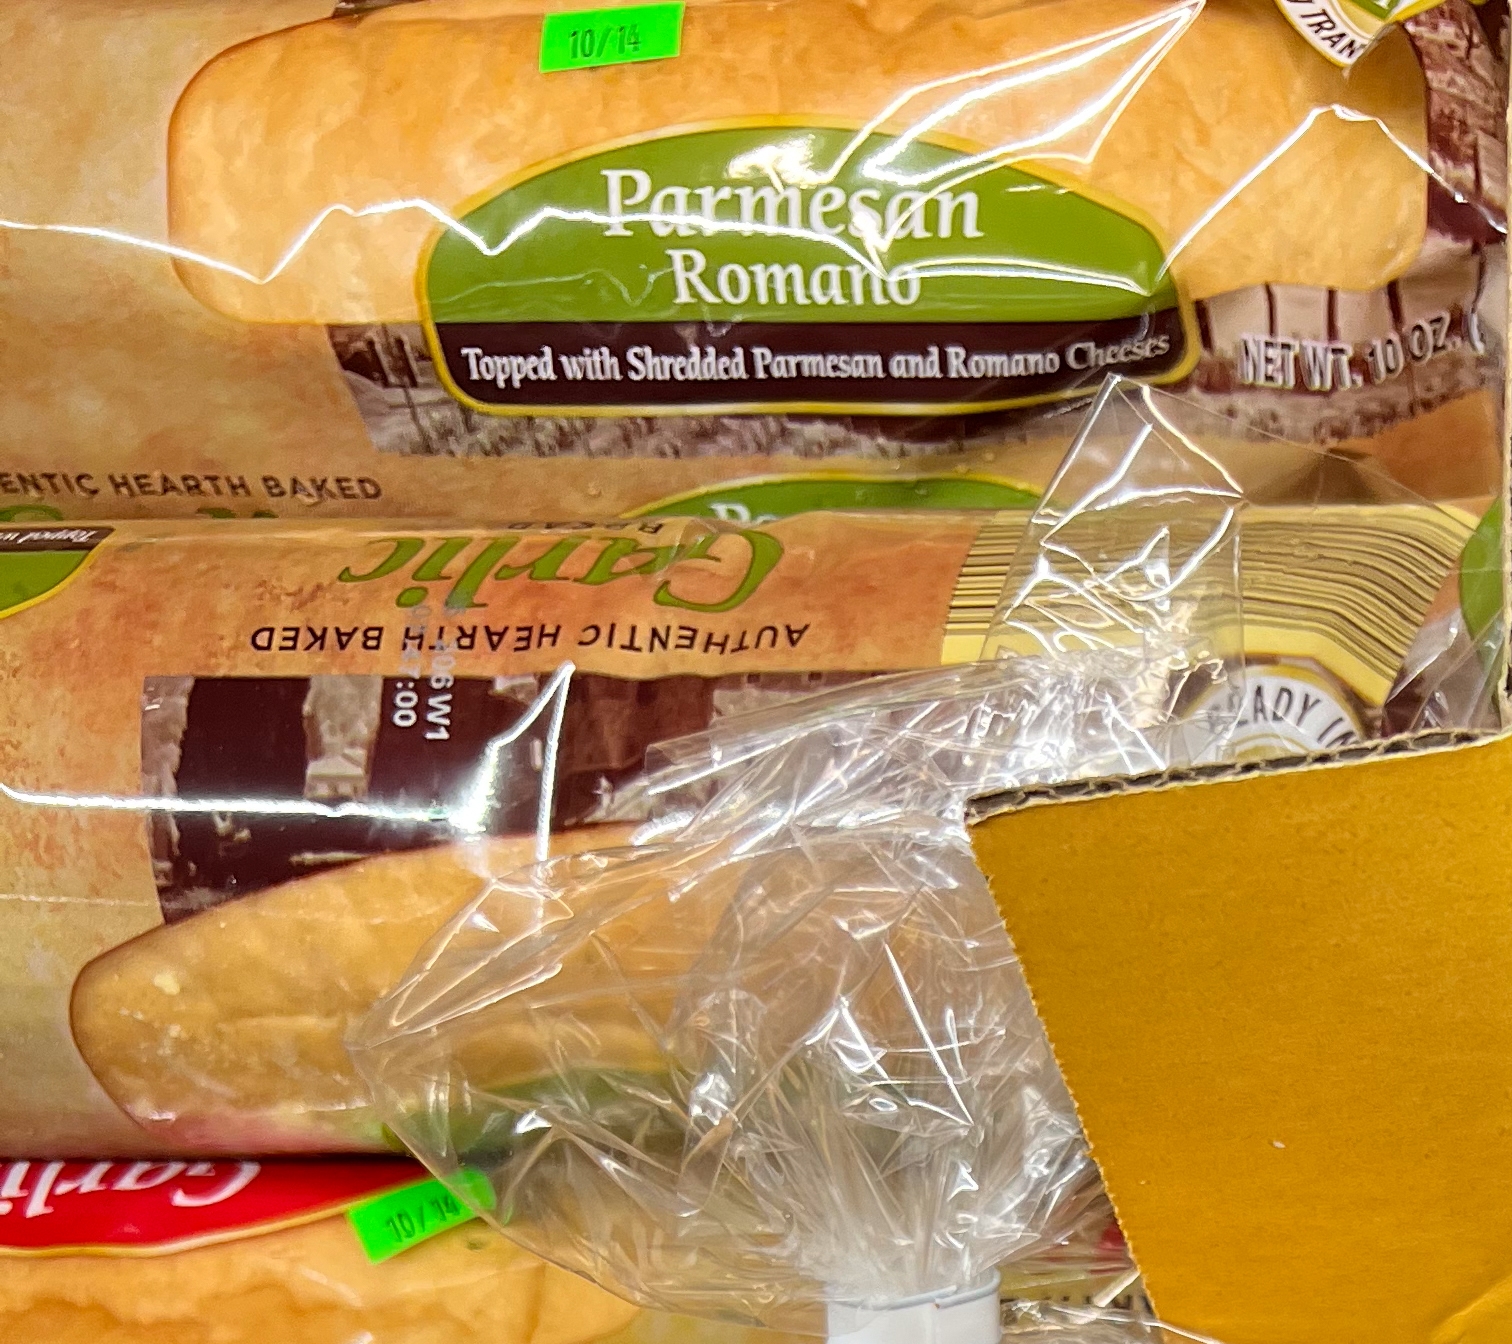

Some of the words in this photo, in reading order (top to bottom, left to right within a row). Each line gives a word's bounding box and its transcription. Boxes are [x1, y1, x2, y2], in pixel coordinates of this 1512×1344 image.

[568, 24, 642, 59] 10/14
[601, 169, 984, 239] Parmesan
[665, 248, 922, 306] Romano
[461, 345, 557, 389] Topped
[559, 346, 623, 380] with
[626, 344, 749, 381] Shredded
[751, 346, 887, 380] Parmesan
[889, 345, 943, 380] and
[944, 342, 1061, 380] Romano
[1065, 334, 1171, 370] Cheeses
[1240, 332, 1299, 390] NET
[1301, 336, 1363, 392] WT.
[1365, 332, 1404, 384] 10
[107, 473, 251, 498] HEARTH
[260, 475, 383, 500] BAKED
[337, 528, 784, 613] Garlic
[251, 625, 383, 651] BAKED
[401, 624, 561, 653] HEARTH
[578, 622, 811, 656] AUTHENTIC
